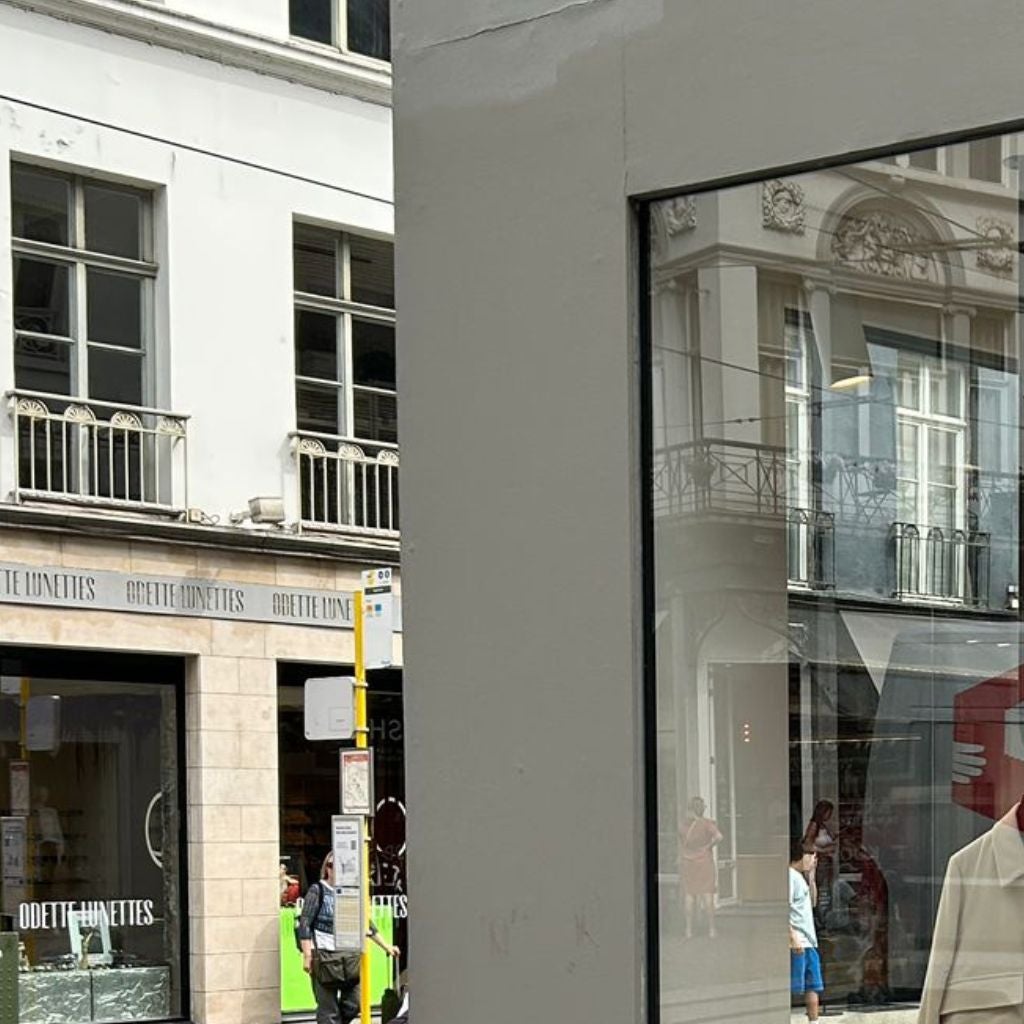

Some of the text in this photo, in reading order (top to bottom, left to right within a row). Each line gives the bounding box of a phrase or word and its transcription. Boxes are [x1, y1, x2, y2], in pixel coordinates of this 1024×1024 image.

[26, 572, 95, 601] LUNETTES
[126, 580, 244, 613] ODETTE LUNETTES
[272, 592, 318, 618] ODETTE
[19, 901, 76, 929] ODETTE
